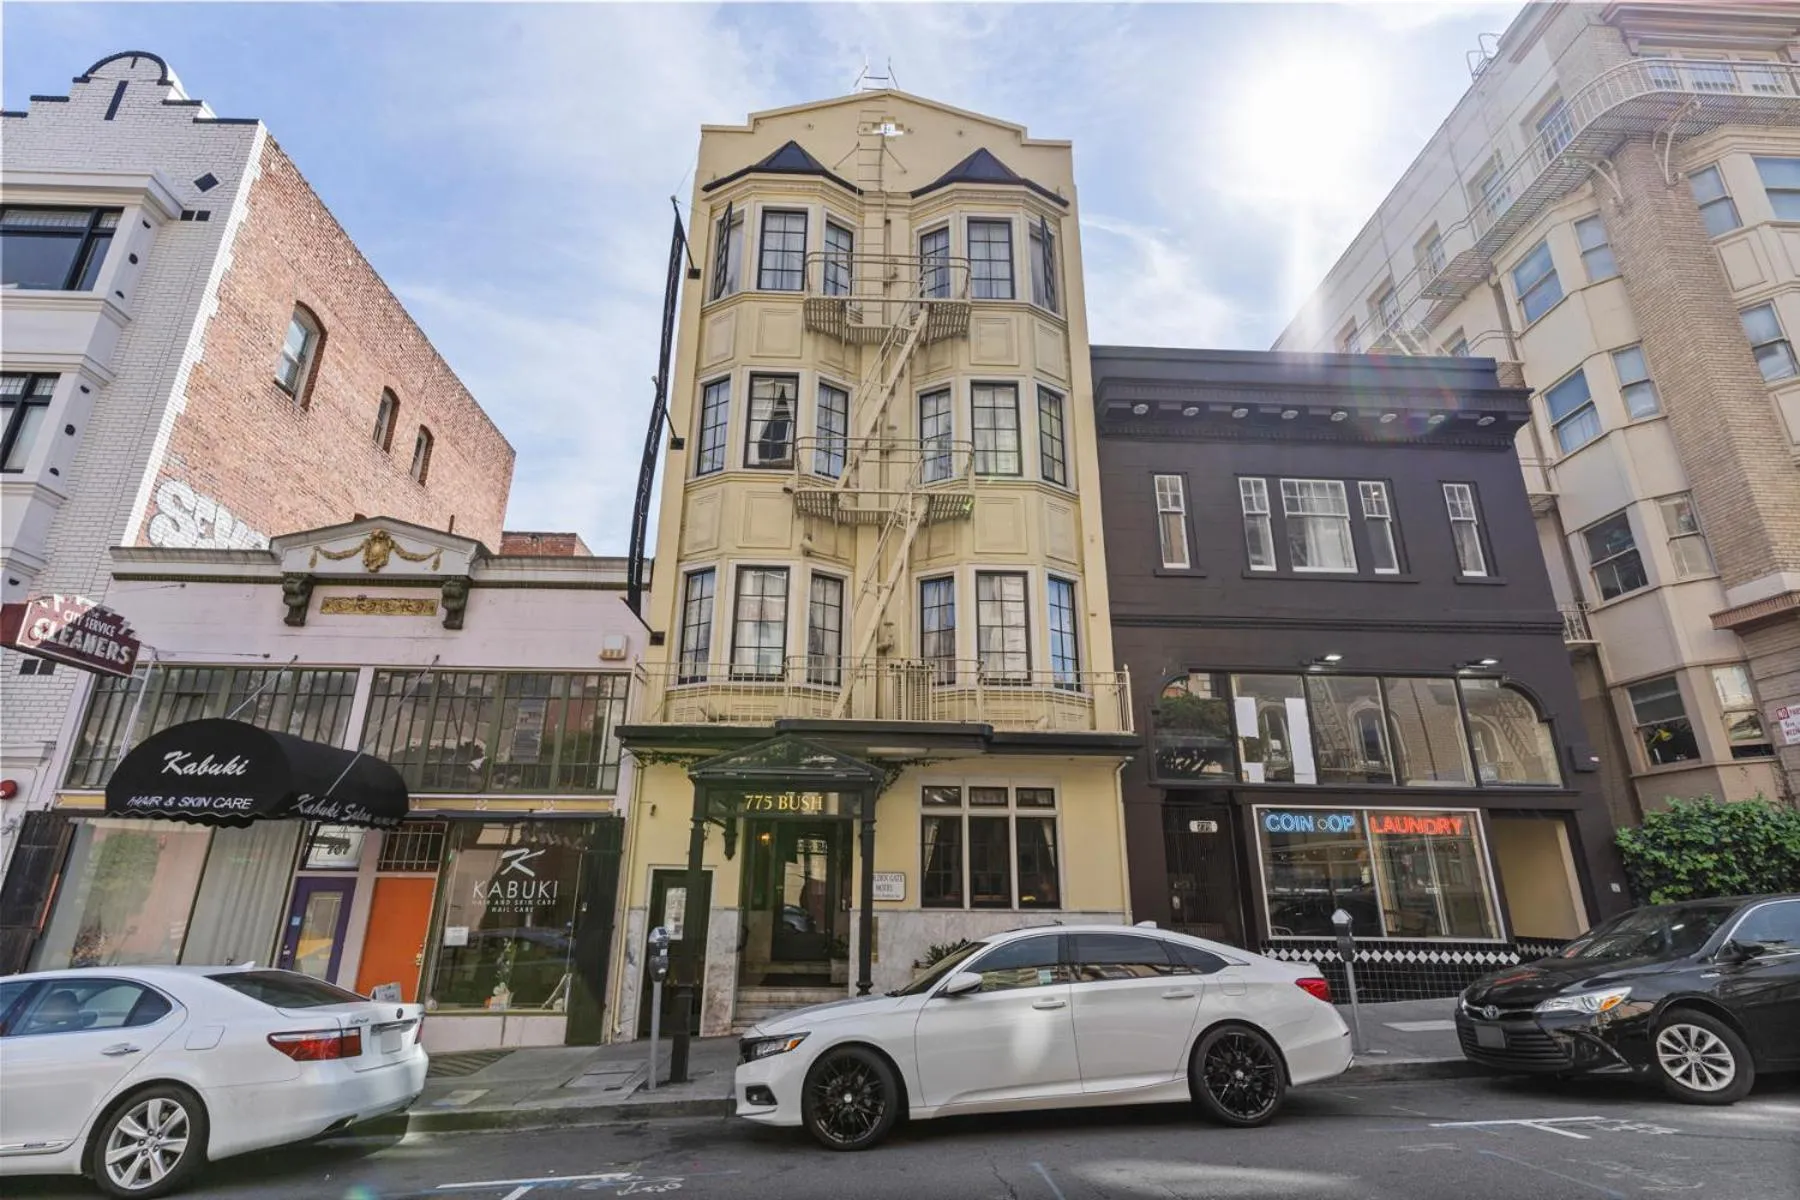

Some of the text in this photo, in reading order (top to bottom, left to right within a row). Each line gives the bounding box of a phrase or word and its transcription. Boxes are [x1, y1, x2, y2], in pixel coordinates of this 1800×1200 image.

[63, 610, 83, 625] CITY
[84, 616, 117, 637] SERVICE
[32, 617, 131, 665] CLEANERS
[161, 750, 249, 776] Kabuki
[127, 795, 254, 810] HAIR & SKIN CARE
[290, 793, 341, 818] Kabuki
[744, 794, 823, 811] 775 BUSH
[1265, 813, 1464, 836] COIN OP LAUNDRY
[472, 880, 559, 899] KABUKI
